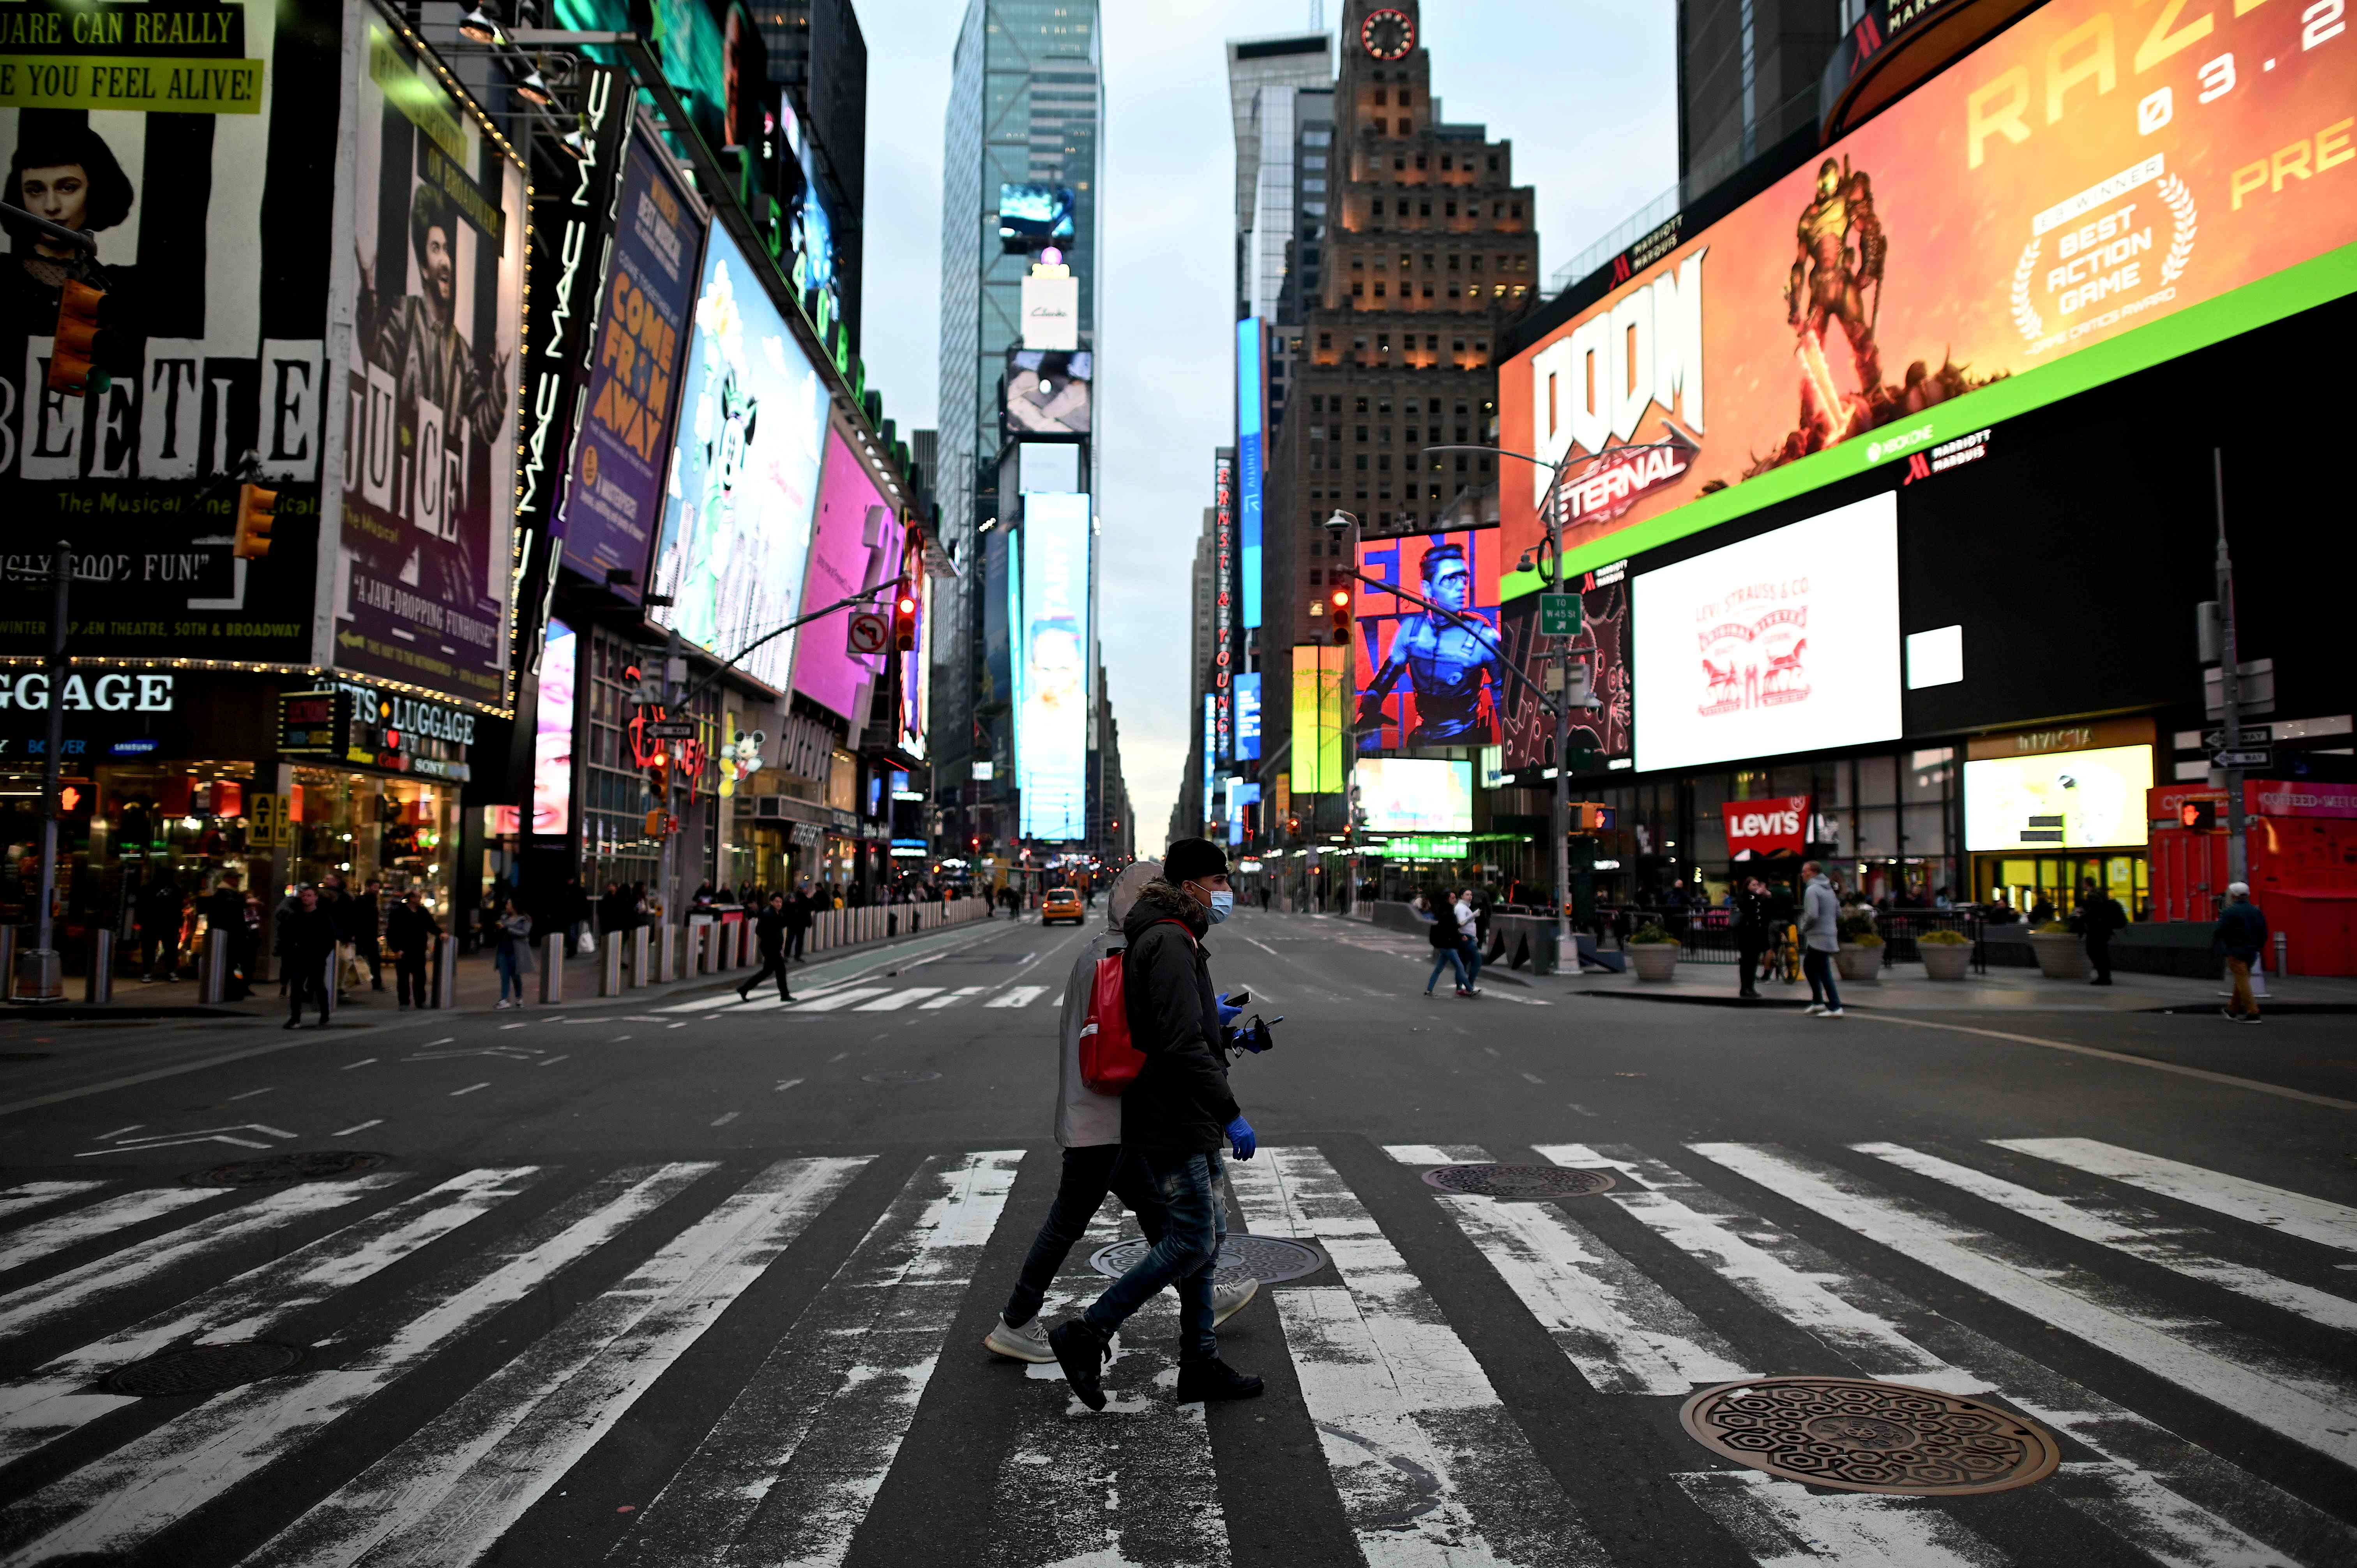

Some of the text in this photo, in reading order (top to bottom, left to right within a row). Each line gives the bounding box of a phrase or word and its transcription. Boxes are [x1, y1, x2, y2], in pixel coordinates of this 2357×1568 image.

[73, 12, 123, 44] CAN
[134, 12, 234, 44] REALLY
[28, 65, 80, 97] YOU
[91, 66, 156, 98] FEEL
[167, 69, 253, 101] ALIVE!
[2076, 161, 2157, 209] WINNER
[2059, 203, 2137, 260] BEST
[2047, 227, 2152, 293] ACTION
[2059, 261, 2141, 316] GAME
[613, 271, 677, 374] COME
[602, 316, 670, 424] FROM
[1530, 244, 1710, 510] DOOM
[592, 375, 661, 463] AWAY
[100, 493, 182, 515] Musical
[1216, 469, 1230, 733] ERNST & YOUNG
[1546, 609, 1576, 618] W 45 St
[1556, 599, 1567, 607] TO
[110, 622, 168, 639] THEATRE,
[226, 623, 301, 639] BROADWAY
[391, 696, 475, 746] LUGGAGE
[414, 757, 445, 775] SONY
[255, 796, 270, 839] ATM
